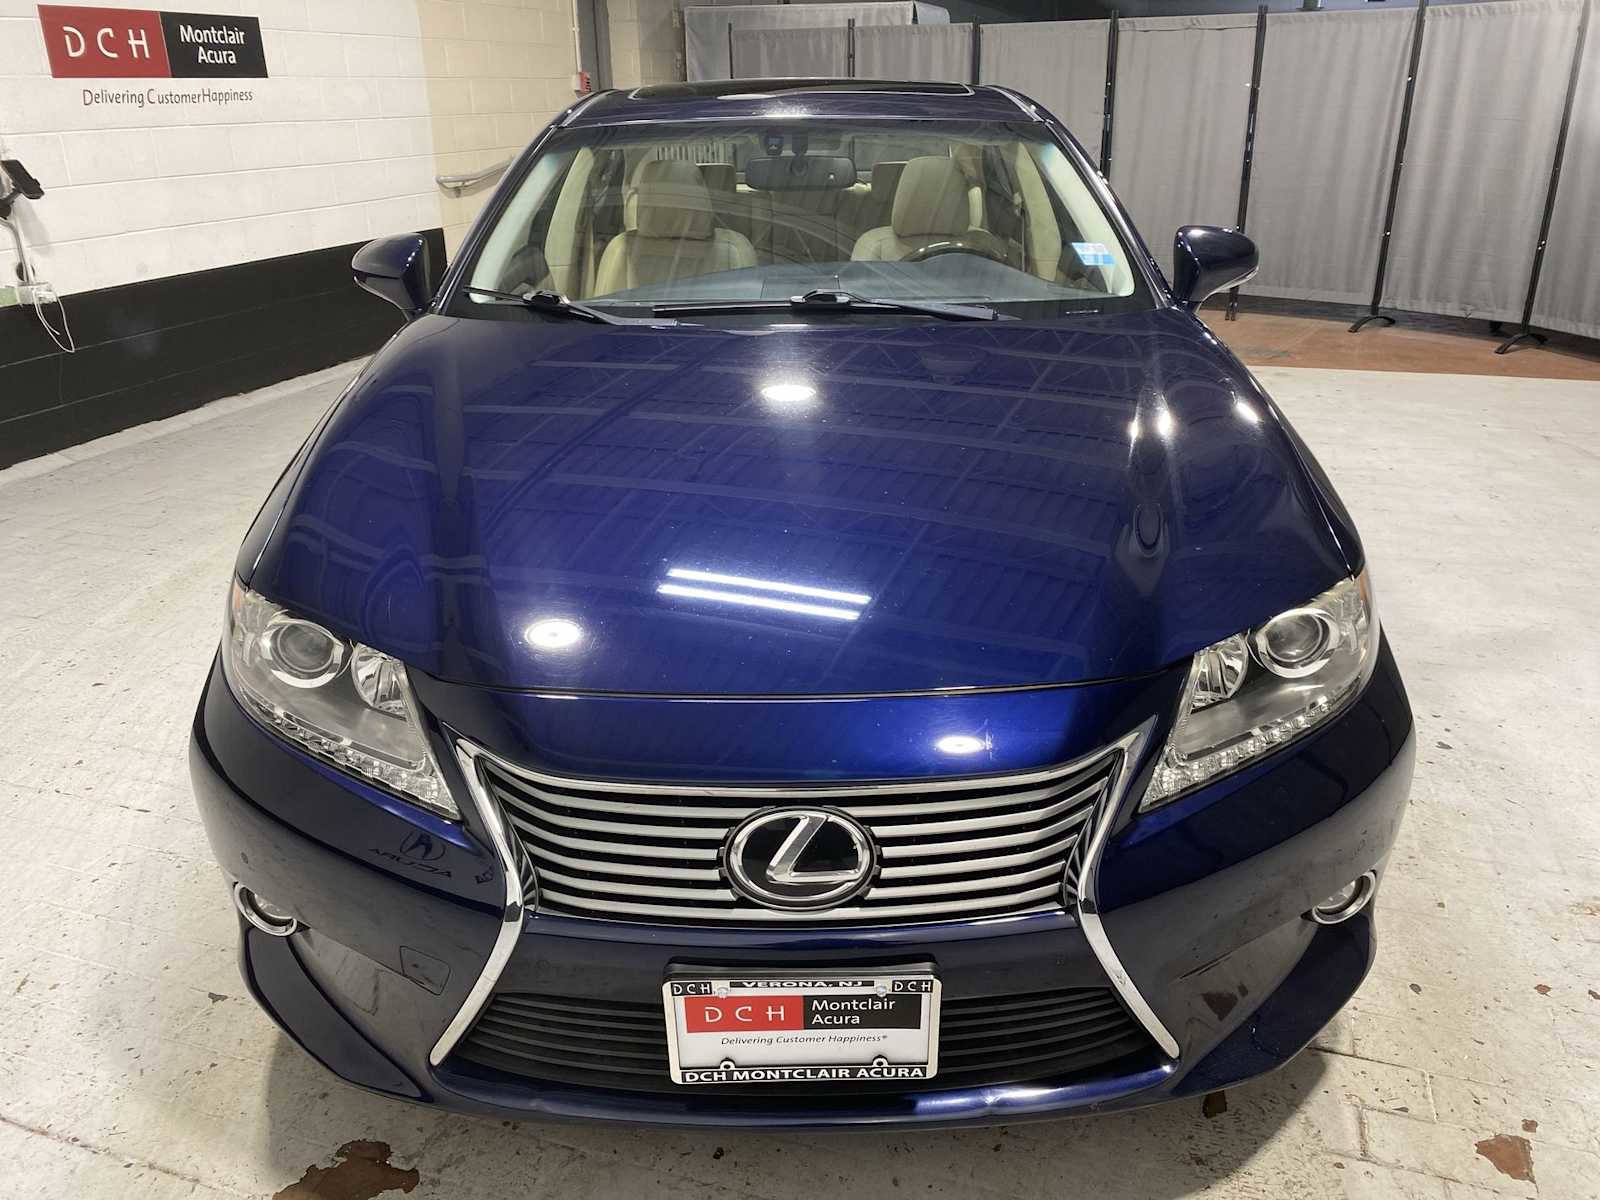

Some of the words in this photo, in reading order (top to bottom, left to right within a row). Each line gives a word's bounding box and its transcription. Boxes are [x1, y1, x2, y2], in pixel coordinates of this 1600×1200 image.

[179, 24, 245, 45] Montclair
[197, 46, 237, 64] Acura
[82, 89, 144, 108] Delivering
[811, 998, 896, 1011] Montclair
[811, 1013, 861, 1025] Acura
[721, 1036, 773, 1045] Delivering
[776, 1035, 825, 1044] Customer
[685, 1070, 727, 1082] DCH
[733, 1068, 851, 1081] MONTCLAIR
[856, 1067, 924, 1078] ACURA
